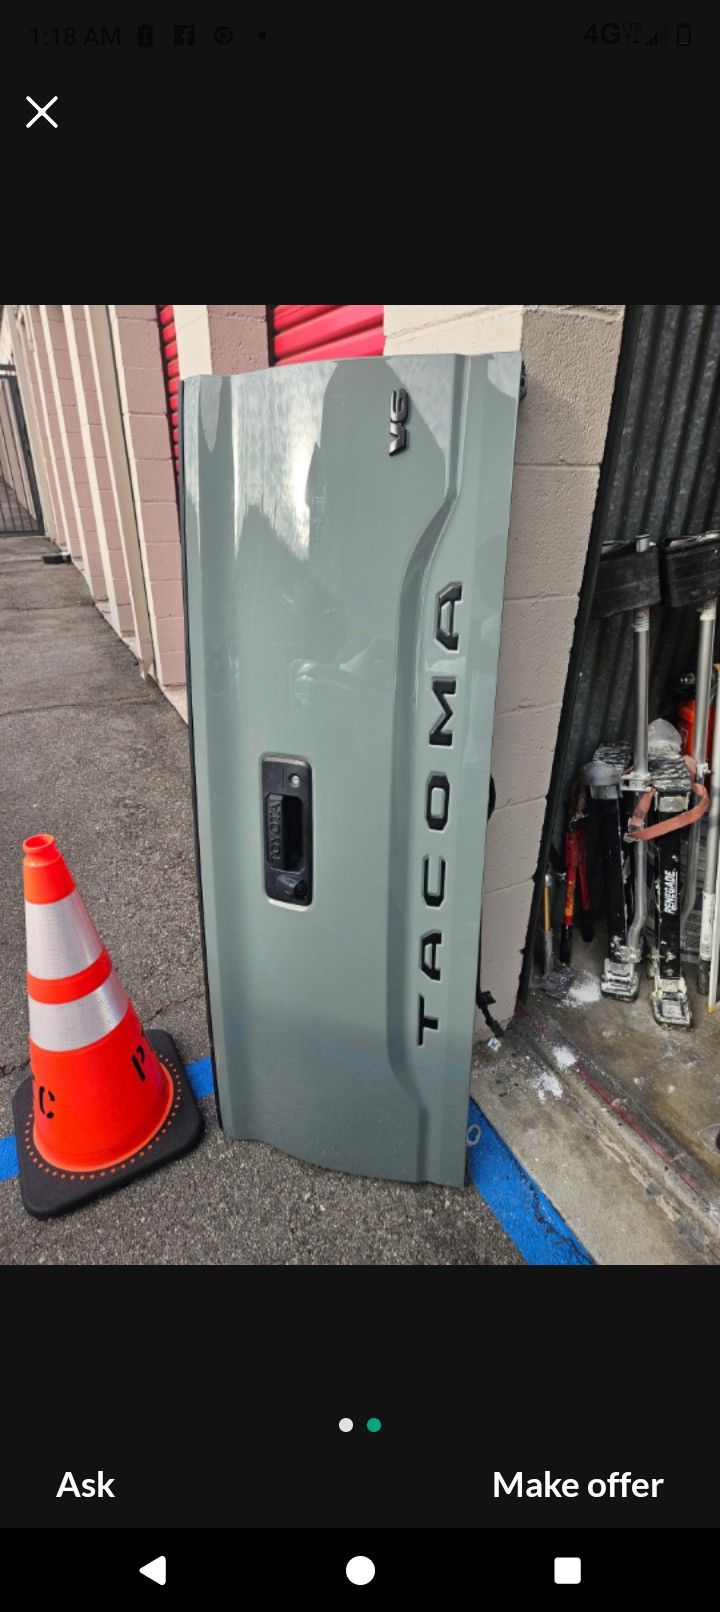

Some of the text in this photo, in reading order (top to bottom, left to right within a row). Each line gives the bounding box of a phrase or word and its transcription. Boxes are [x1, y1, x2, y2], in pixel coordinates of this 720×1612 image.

[389, 388, 408, 457] V6
[270, 800, 281, 861] TOYOTA
[415, 580, 463, 1047] TACOMA
[664, 870, 677, 915] RENEGADE
